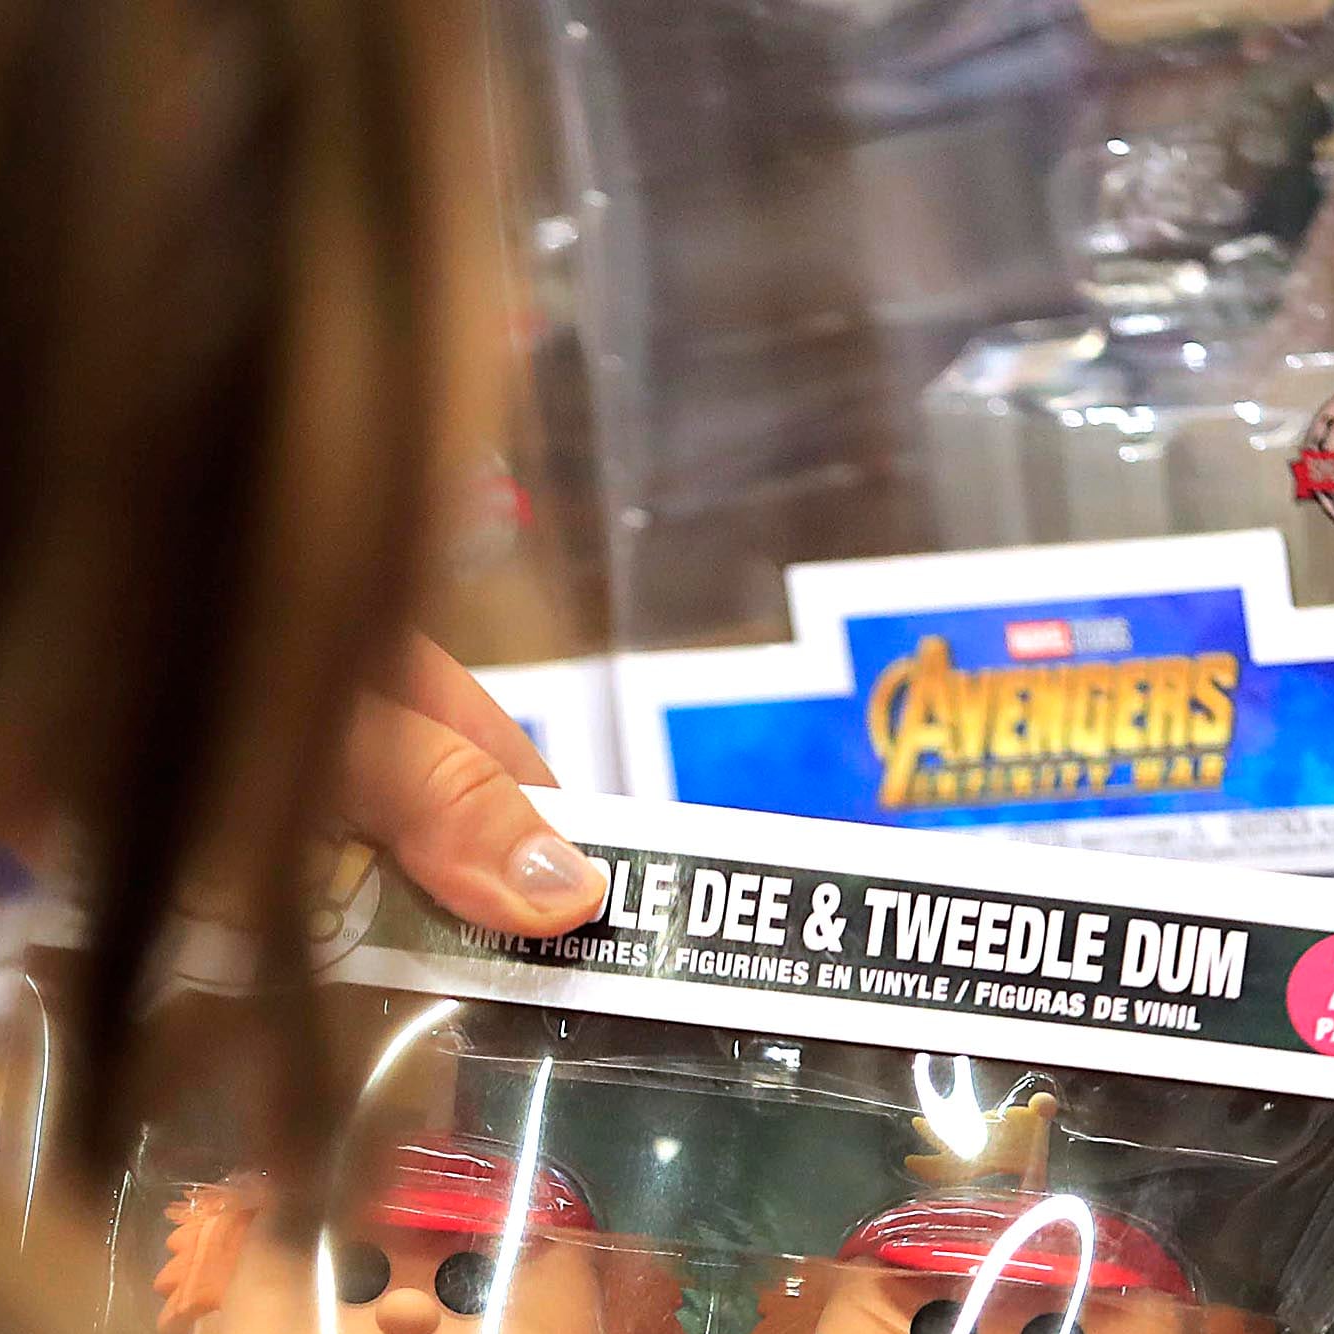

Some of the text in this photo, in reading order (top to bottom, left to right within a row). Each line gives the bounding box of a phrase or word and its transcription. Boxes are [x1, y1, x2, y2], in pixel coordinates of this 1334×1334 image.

[869, 634, 1240, 811] AVENGERS
[540, 933, 649, 968] FIGURES
[674, 947, 810, 987] FIGURINES
[817, 962, 853, 991] EN
[859, 966, 951, 1002] VINYLE
[973, 980, 1087, 1018] FIGURAS
[1092, 994, 1130, 1023] DE
[1133, 999, 1203, 1032] VINIL
[585, 856, 1250, 1000] LE DEE & TWEEDLE DUM
